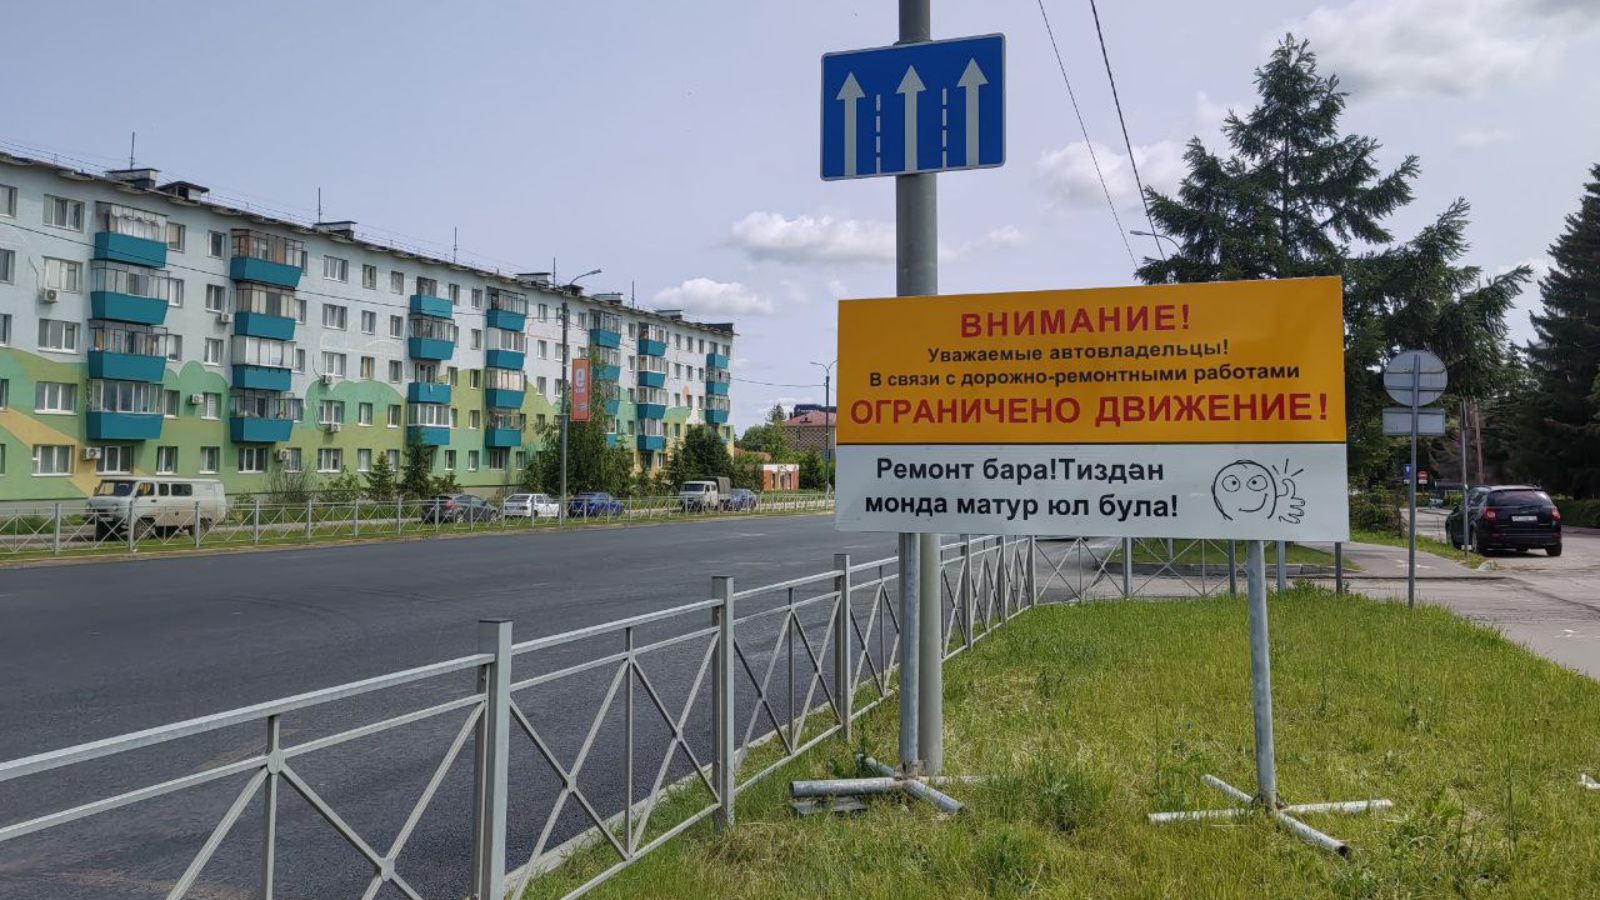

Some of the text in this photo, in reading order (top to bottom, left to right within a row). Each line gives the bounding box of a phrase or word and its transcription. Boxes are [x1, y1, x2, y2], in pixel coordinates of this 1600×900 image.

[960, 303, 1190, 339] ВНИМАНИЕ!
[927, 338, 1228, 363] Уважаемые автовладельцы!
[869, 363, 1300, 388] В связи с дорожно-ремонтными работами
[850, 391, 1327, 428] ОГРАНИЧЕНО ДВИЖЕНИЕ!
[876, 457, 975, 480] Ремонт
[865, 493, 1178, 523] монда матур юл була!
